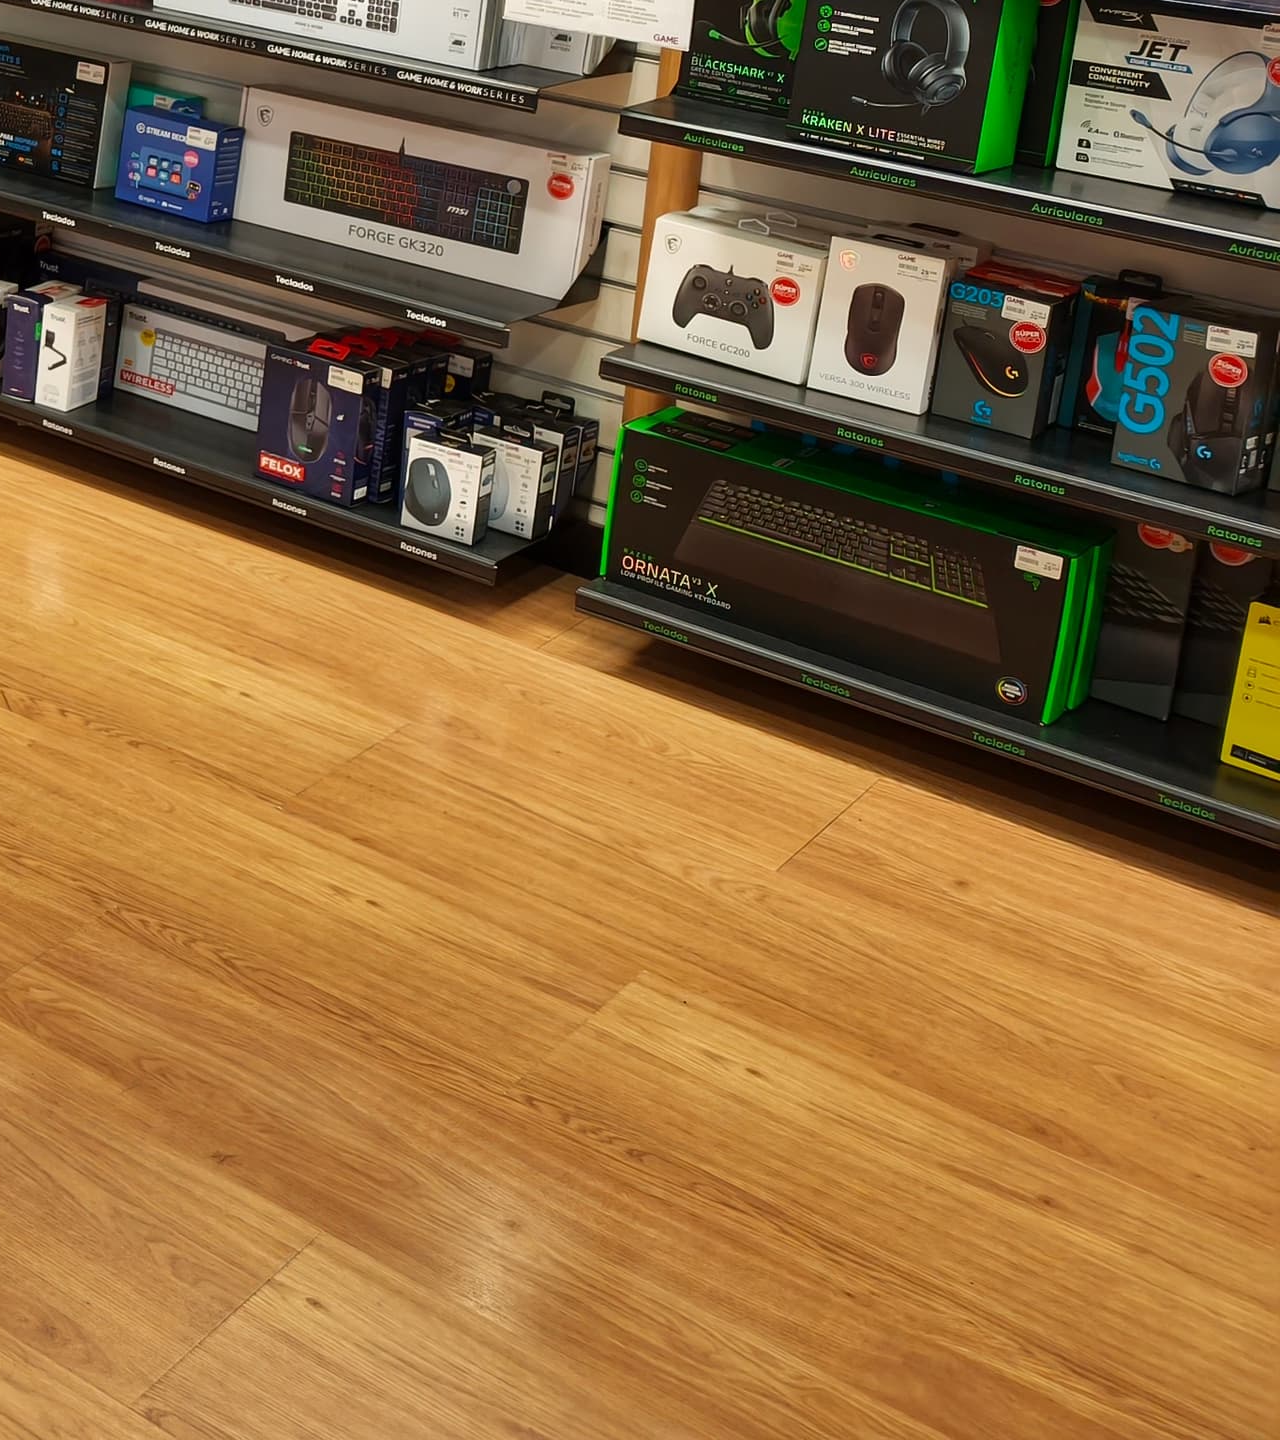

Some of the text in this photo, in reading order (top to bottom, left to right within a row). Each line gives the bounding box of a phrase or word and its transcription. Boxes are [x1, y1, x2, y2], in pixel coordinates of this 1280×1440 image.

[1130, 40, 1187, 61] JET
[1089, 73, 1150, 88] CONNECTIVITY
[1090, 65, 1144, 80] CONVENIENT
[802, 114, 896, 142] KRAKEN X LITE
[684, 132, 744, 152] Auriculares
[850, 166, 916, 188] Auriculares
[348, 224, 445, 256] FORGE GK320
[951, 281, 1004, 309] G203
[686, 332, 751, 359] FORCE GC200
[121, 371, 175, 396] WIRELESS
[1119, 310, 1179, 434] G502
[837, 428, 884, 447] Ratones
[260, 456, 303, 479] FELOX
[1014, 474, 1065, 496] Ratones
[622, 554, 718, 599] ORNATA X
[643, 621, 688, 643] Teclados
[972, 731, 1026, 756] Teclados
